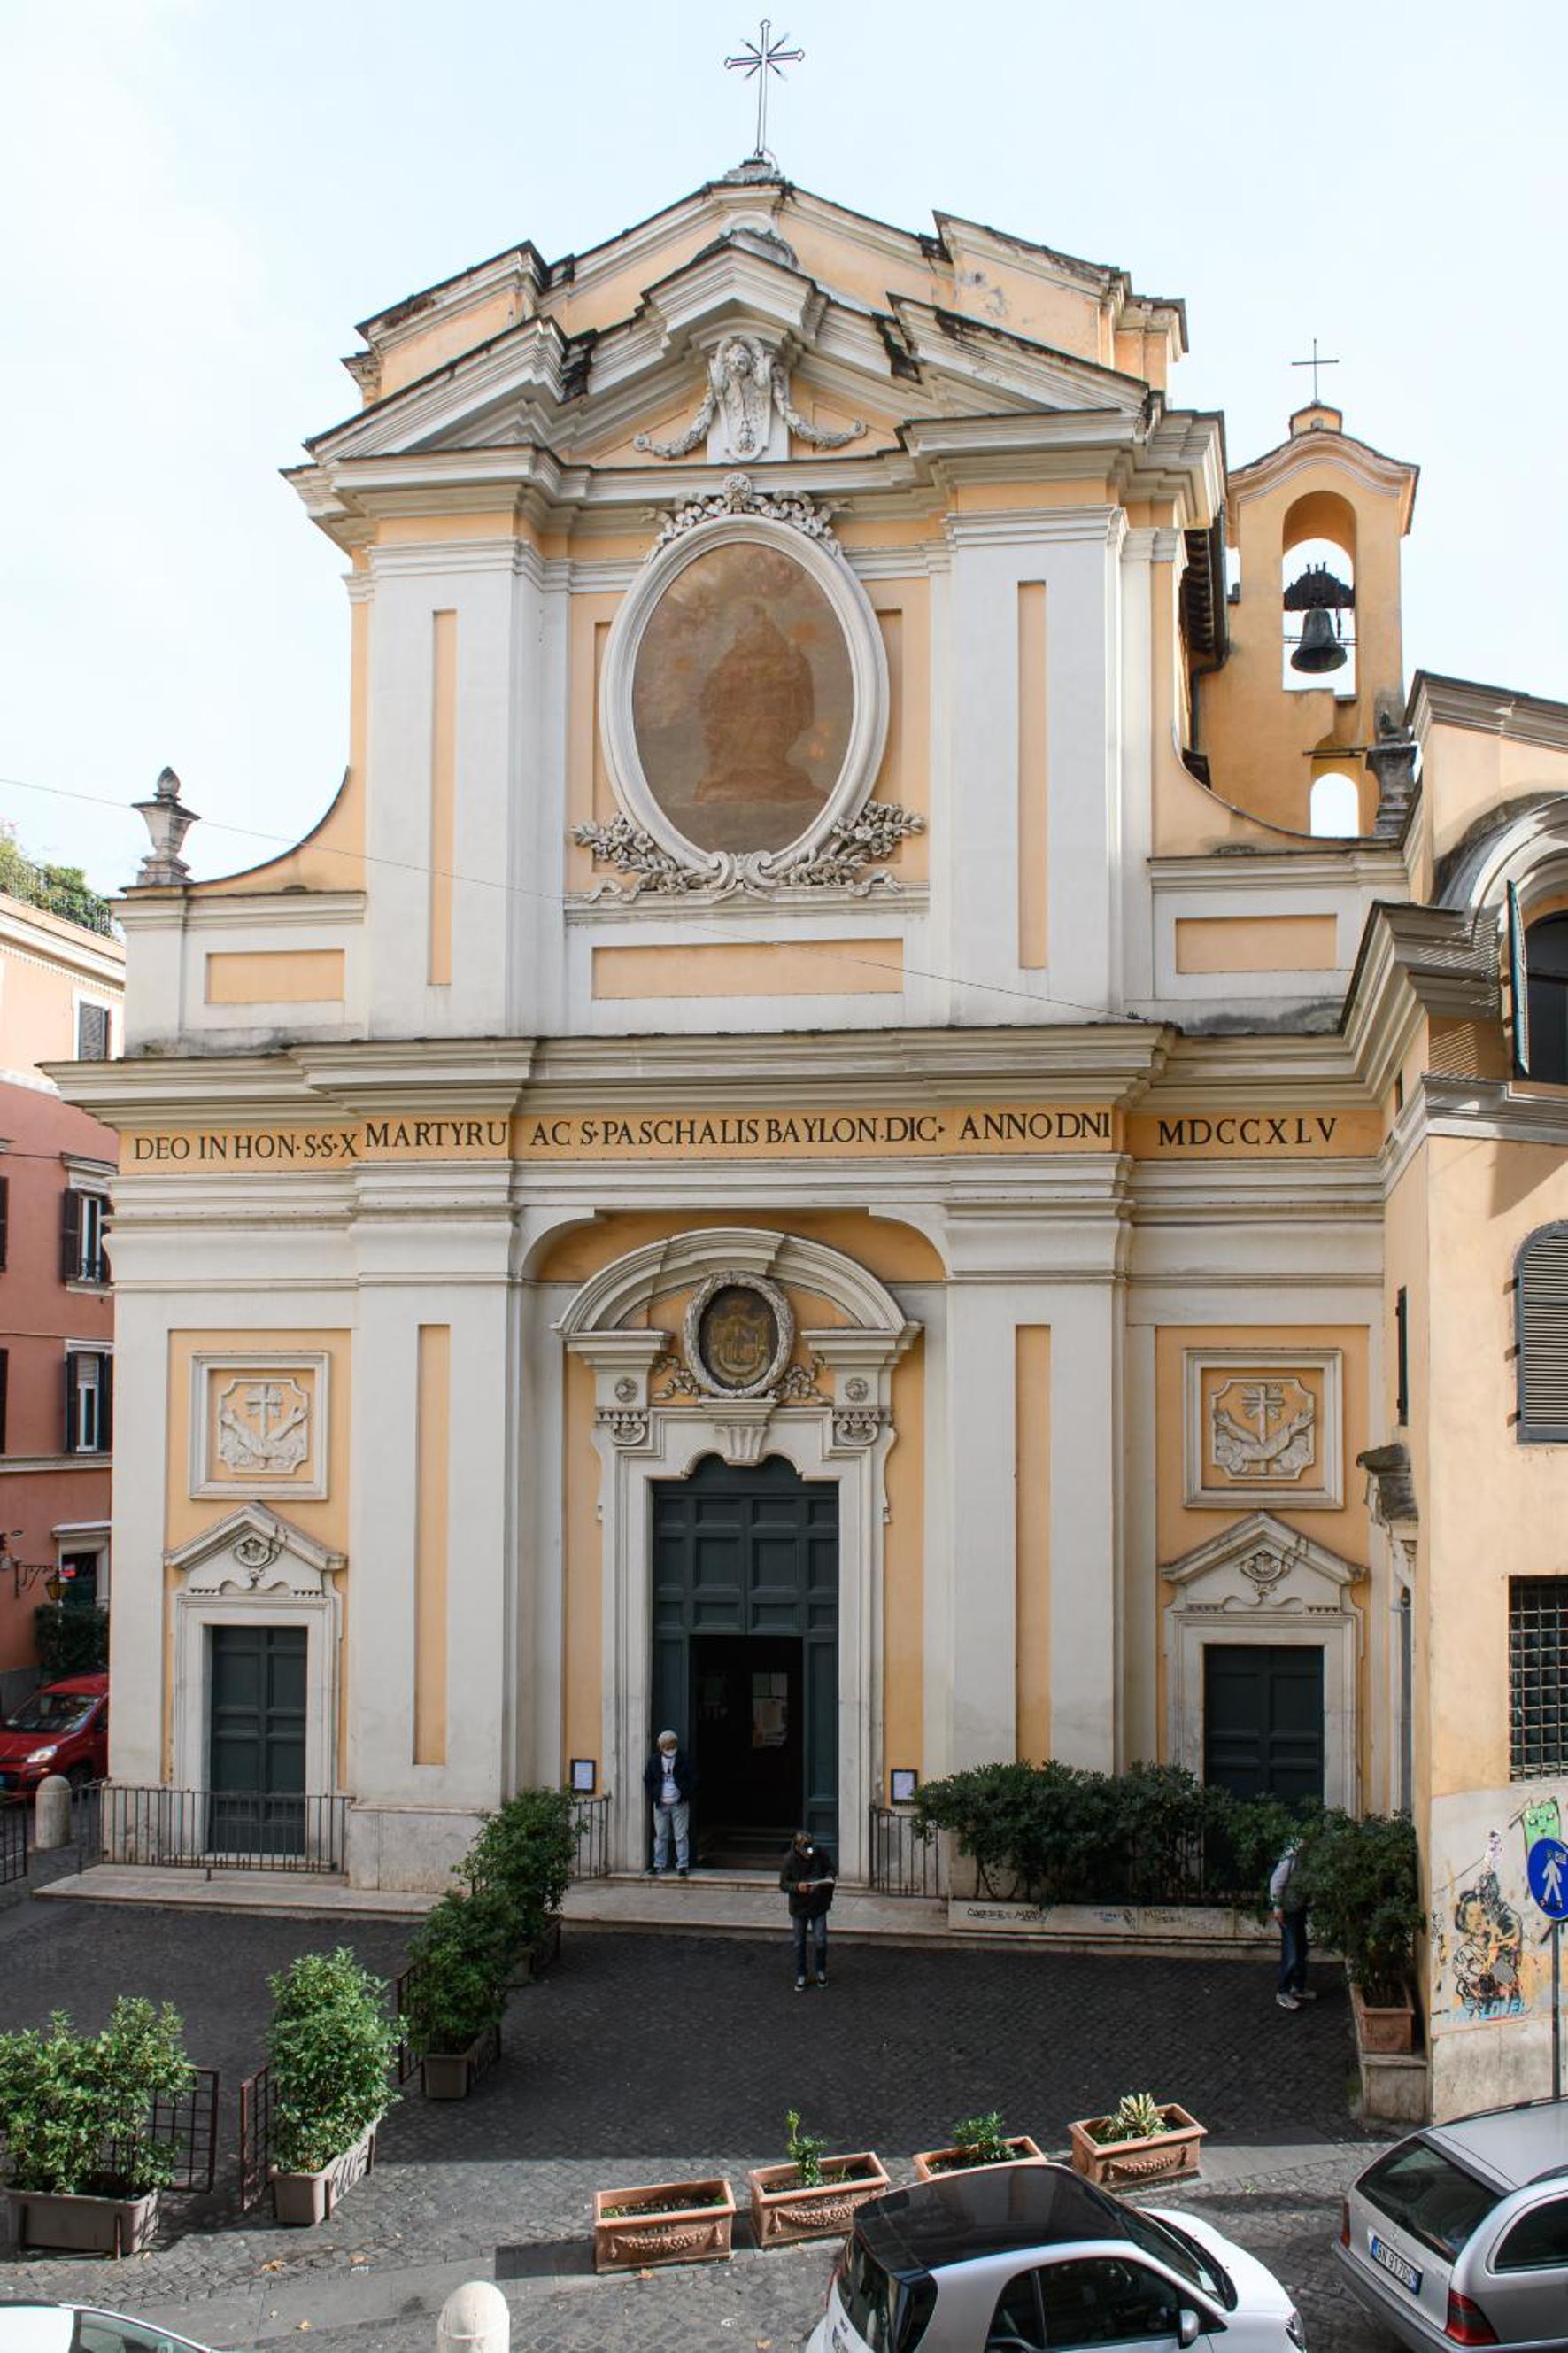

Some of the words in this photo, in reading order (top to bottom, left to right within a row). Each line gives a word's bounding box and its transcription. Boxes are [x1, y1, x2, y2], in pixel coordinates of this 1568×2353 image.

[135, 1135, 190, 1160] DEO
[198, 1135, 228, 1159] IN
[364, 1121, 508, 1148] MARTYRU
[529, 1120, 572, 1146] AC
[959, 1113, 1052, 1141] ANNO
[1055, 1112, 1111, 1139] DNI
[1157, 1118, 1339, 1146] MDCCXLV
